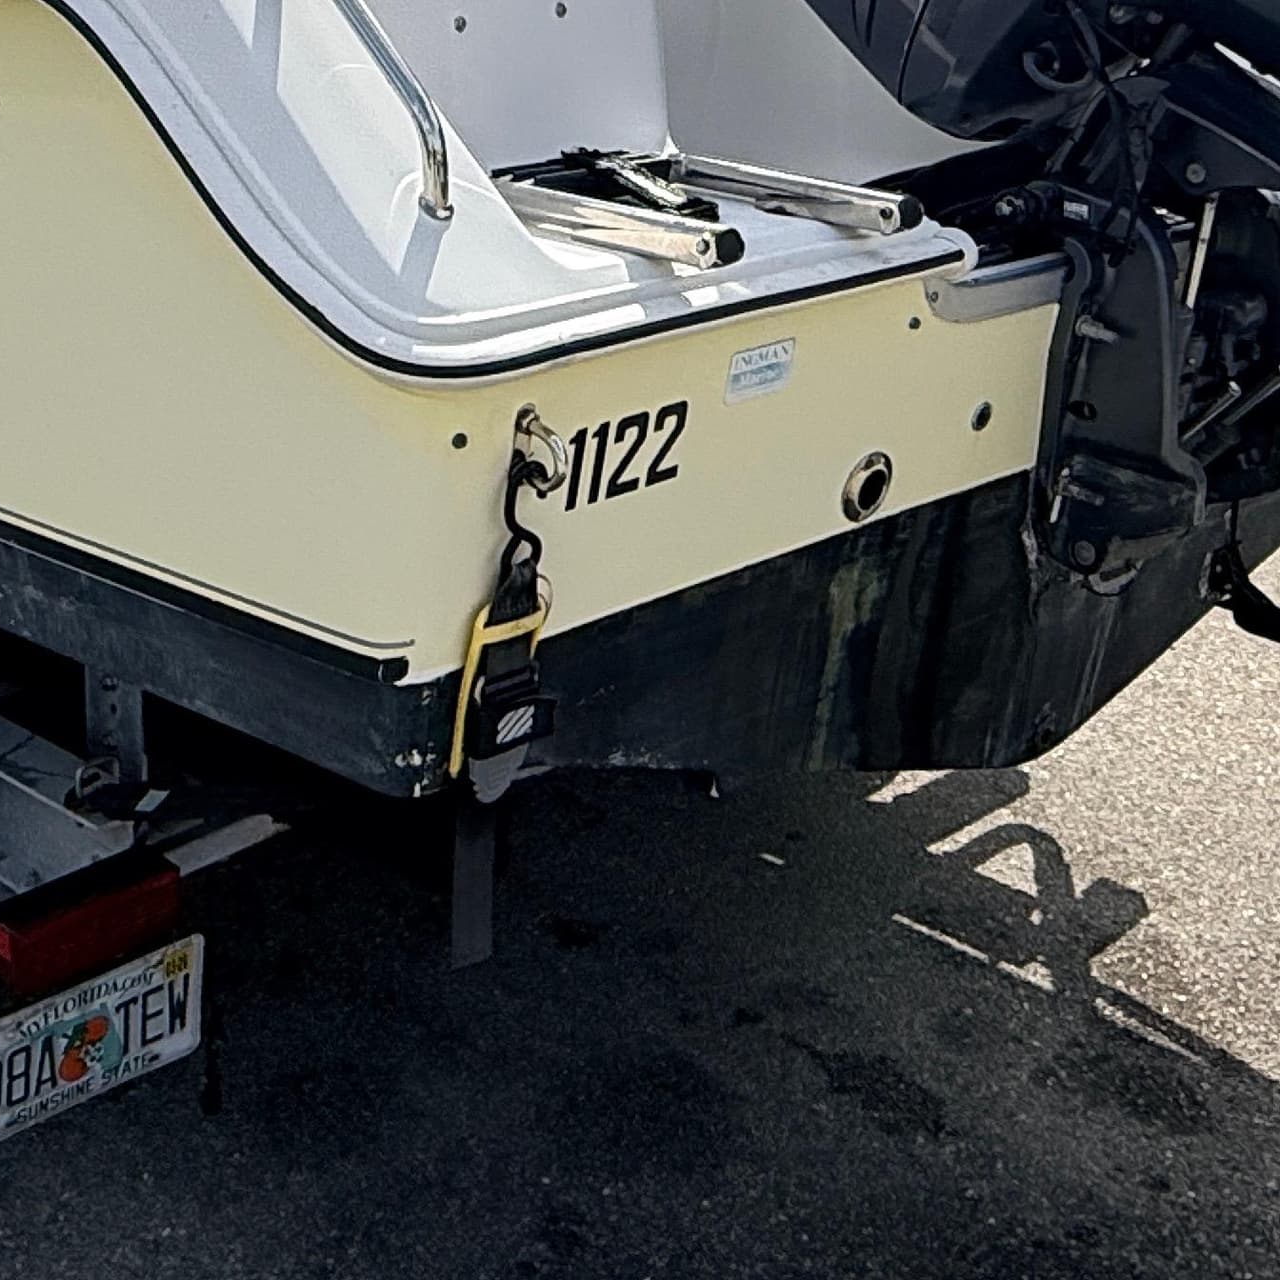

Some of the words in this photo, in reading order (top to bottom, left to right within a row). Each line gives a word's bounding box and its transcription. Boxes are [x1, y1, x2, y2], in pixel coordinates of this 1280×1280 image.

[564, 398, 689, 513] 1122
[114, 972, 191, 1058] TEW
[17, 1077, 96, 1123] SUNSHINE
[102, 1055, 148, 1086] STATE
